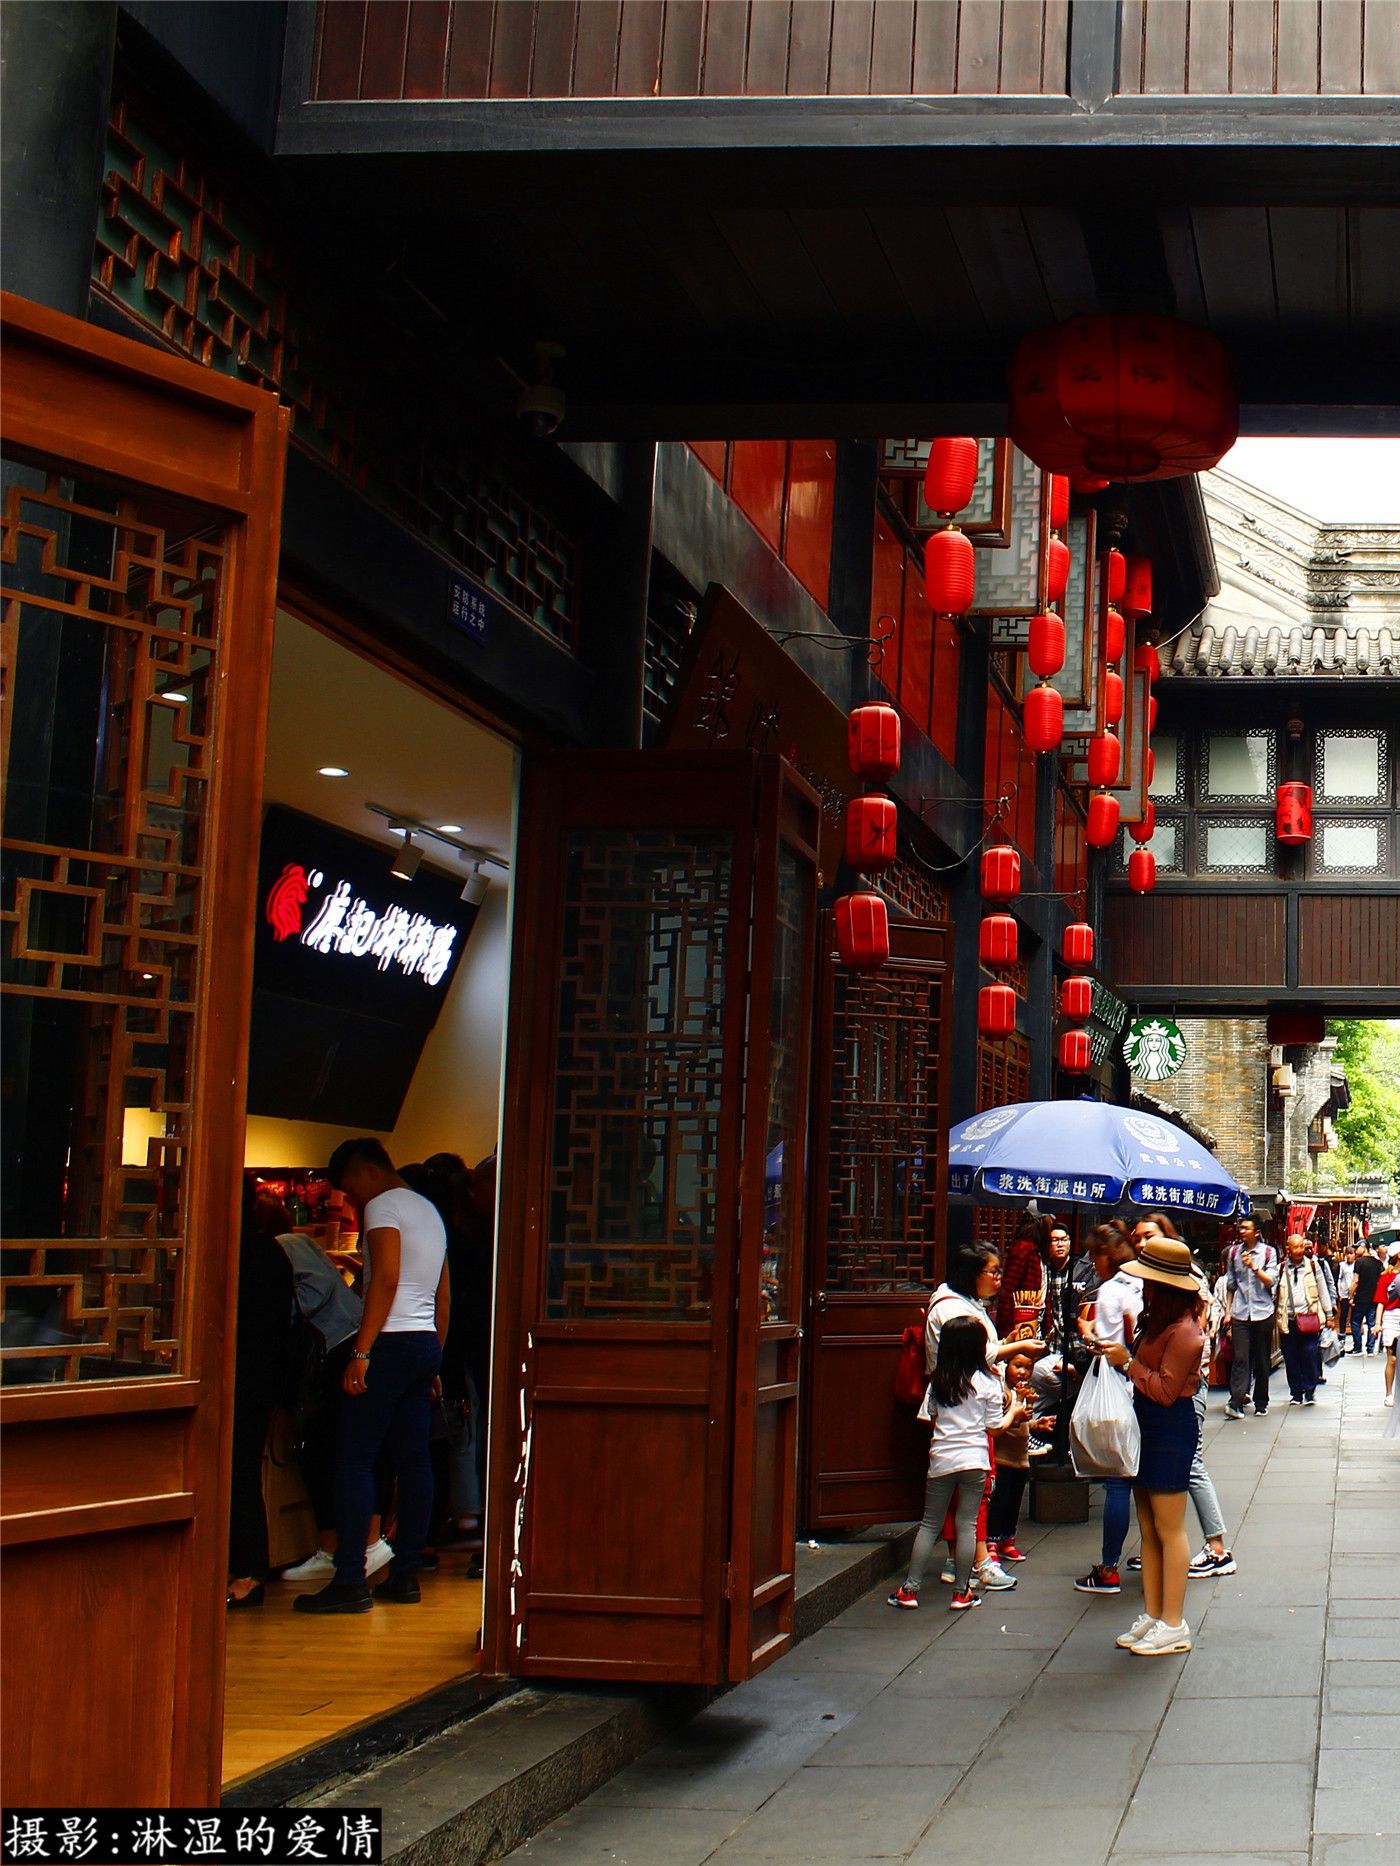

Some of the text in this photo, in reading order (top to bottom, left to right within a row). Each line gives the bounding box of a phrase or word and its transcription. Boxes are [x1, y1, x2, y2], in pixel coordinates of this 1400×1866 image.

[998, 1173, 1106, 1199] 浆洗街派出所
[1141, 1184, 1220, 1209] 浆洗街派出所
